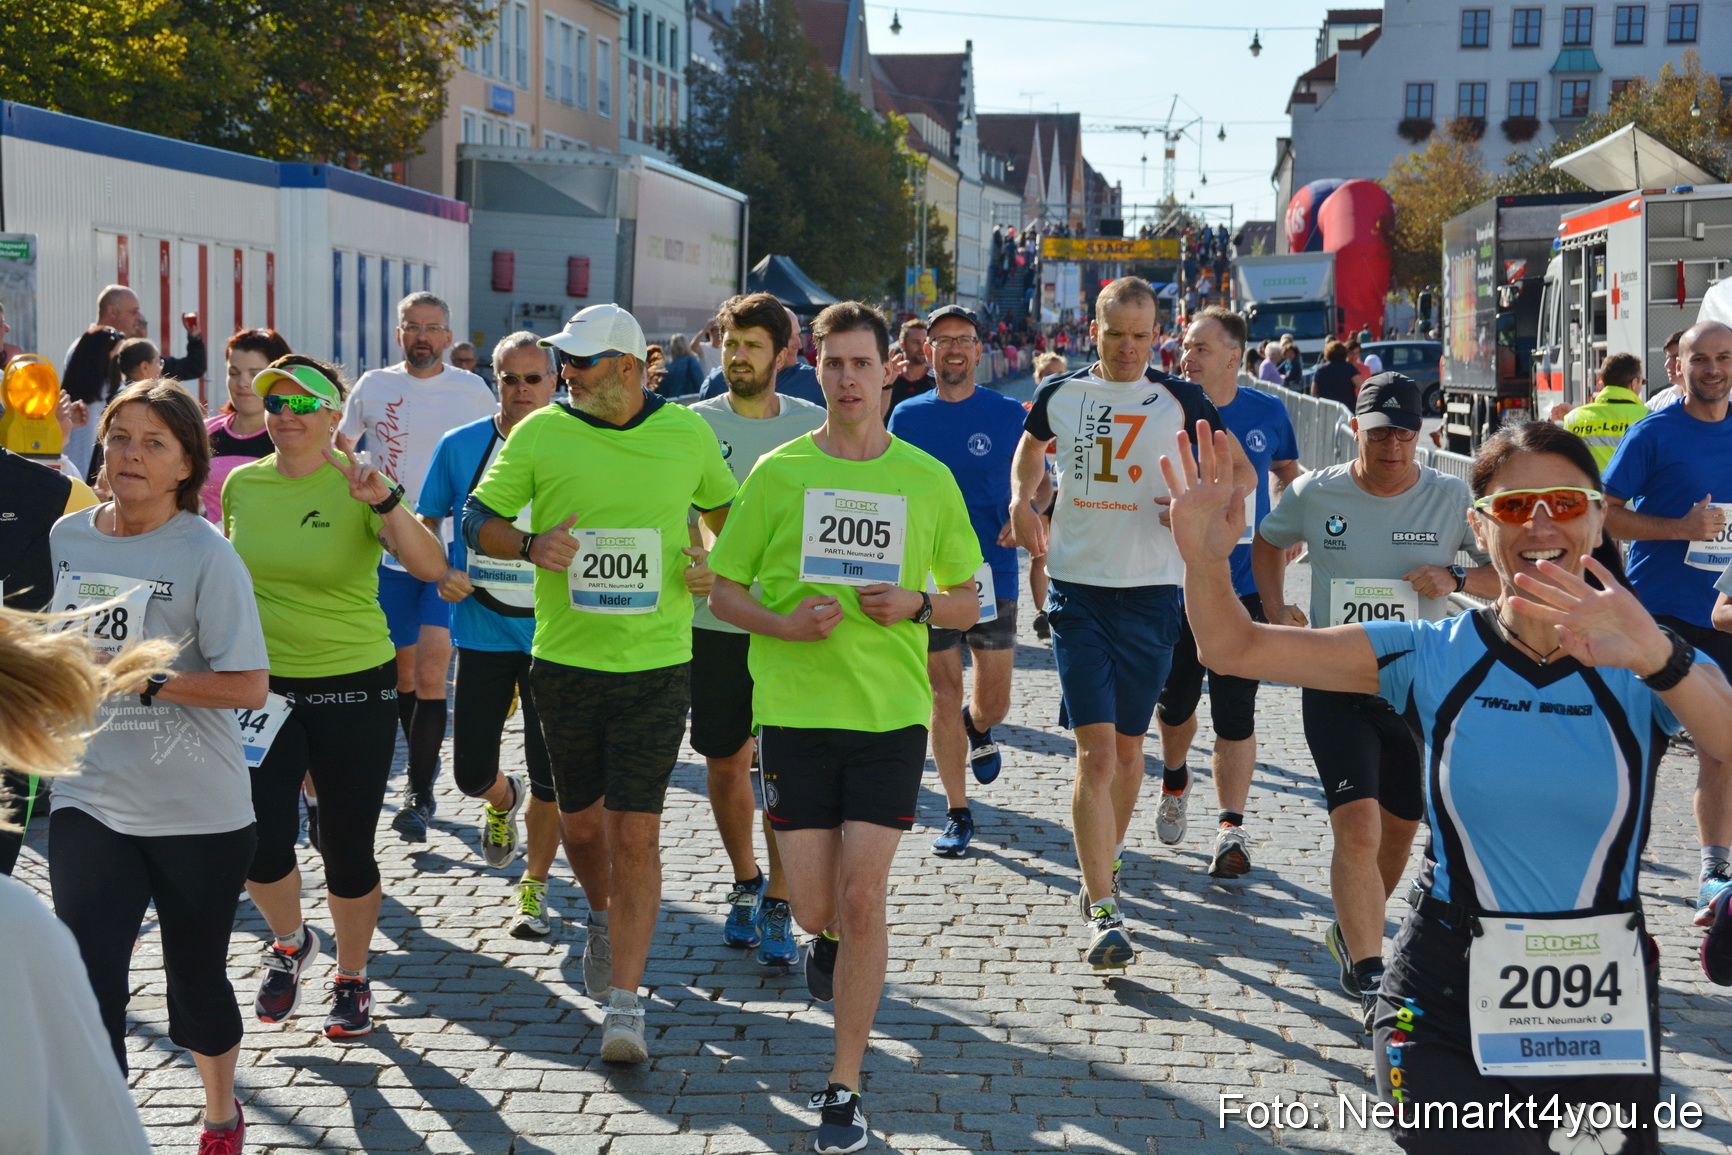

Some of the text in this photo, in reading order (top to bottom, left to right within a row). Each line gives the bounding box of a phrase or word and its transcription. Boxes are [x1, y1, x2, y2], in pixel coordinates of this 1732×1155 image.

[1086, 242, 1135, 254] START
[1084, 414, 1095, 449] LAUF
[1074, 436, 1084, 480] STADT
[835, 498, 879, 512] BOCK
[1073, 497, 1139, 511] SportScheck
[312, 520, 330, 528] Nina
[819, 515, 891, 549] 2005
[1392, 532, 1438, 543] BOCK
[596, 536, 637, 547] BOCK
[1324, 539, 1347, 547] PARTL
[846, 550, 876, 558] Neumarkt
[582, 553, 649, 580] 2004
[842, 562, 863, 576] Tim
[478, 569, 518, 582] Christian
[79, 583, 119, 597] BOCK
[1355, 586, 1394, 596] BOCK
[599, 594, 632, 606] Nader
[1343, 602, 1405, 624] 2095
[1525, 933, 1600, 951] BOCK
[1498, 961, 1622, 1009] 2094
[1509, 1015, 1597, 1025] PARTL Neumarkt
[1519, 1036, 1601, 1057] Barbara
